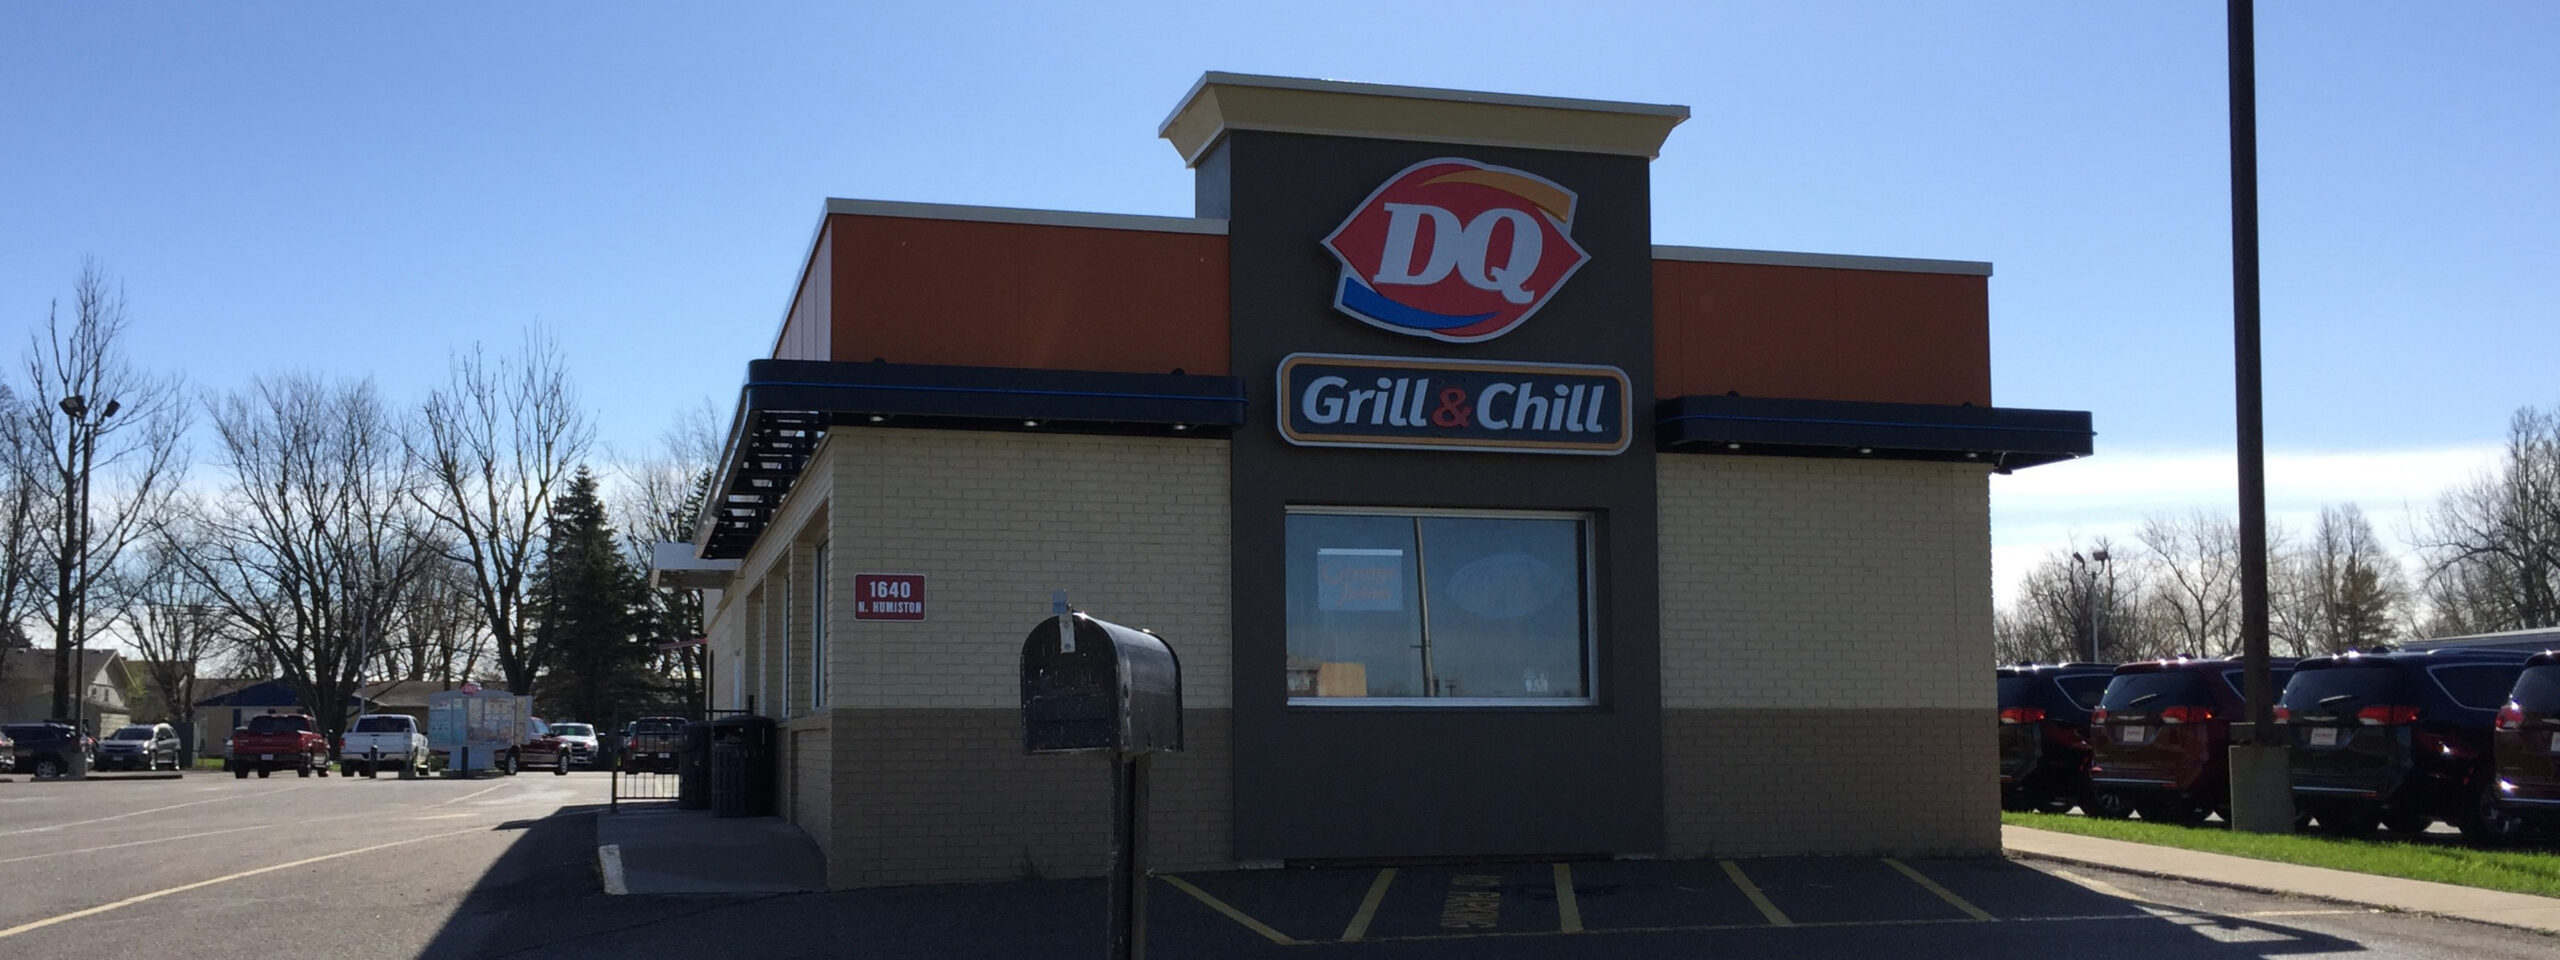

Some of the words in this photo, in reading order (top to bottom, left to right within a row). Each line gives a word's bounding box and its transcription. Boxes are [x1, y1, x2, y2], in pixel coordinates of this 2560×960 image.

[1373, 202, 1543, 304] DQ
[1302, 375, 1429, 428] Grill
[1432, 387, 1473, 429] &
[1476, 382, 1605, 433] Chill
[858, 601, 869, 613] N.
[872, 601, 922, 613] HUMISTON
[869, 581, 911, 598] 1640
